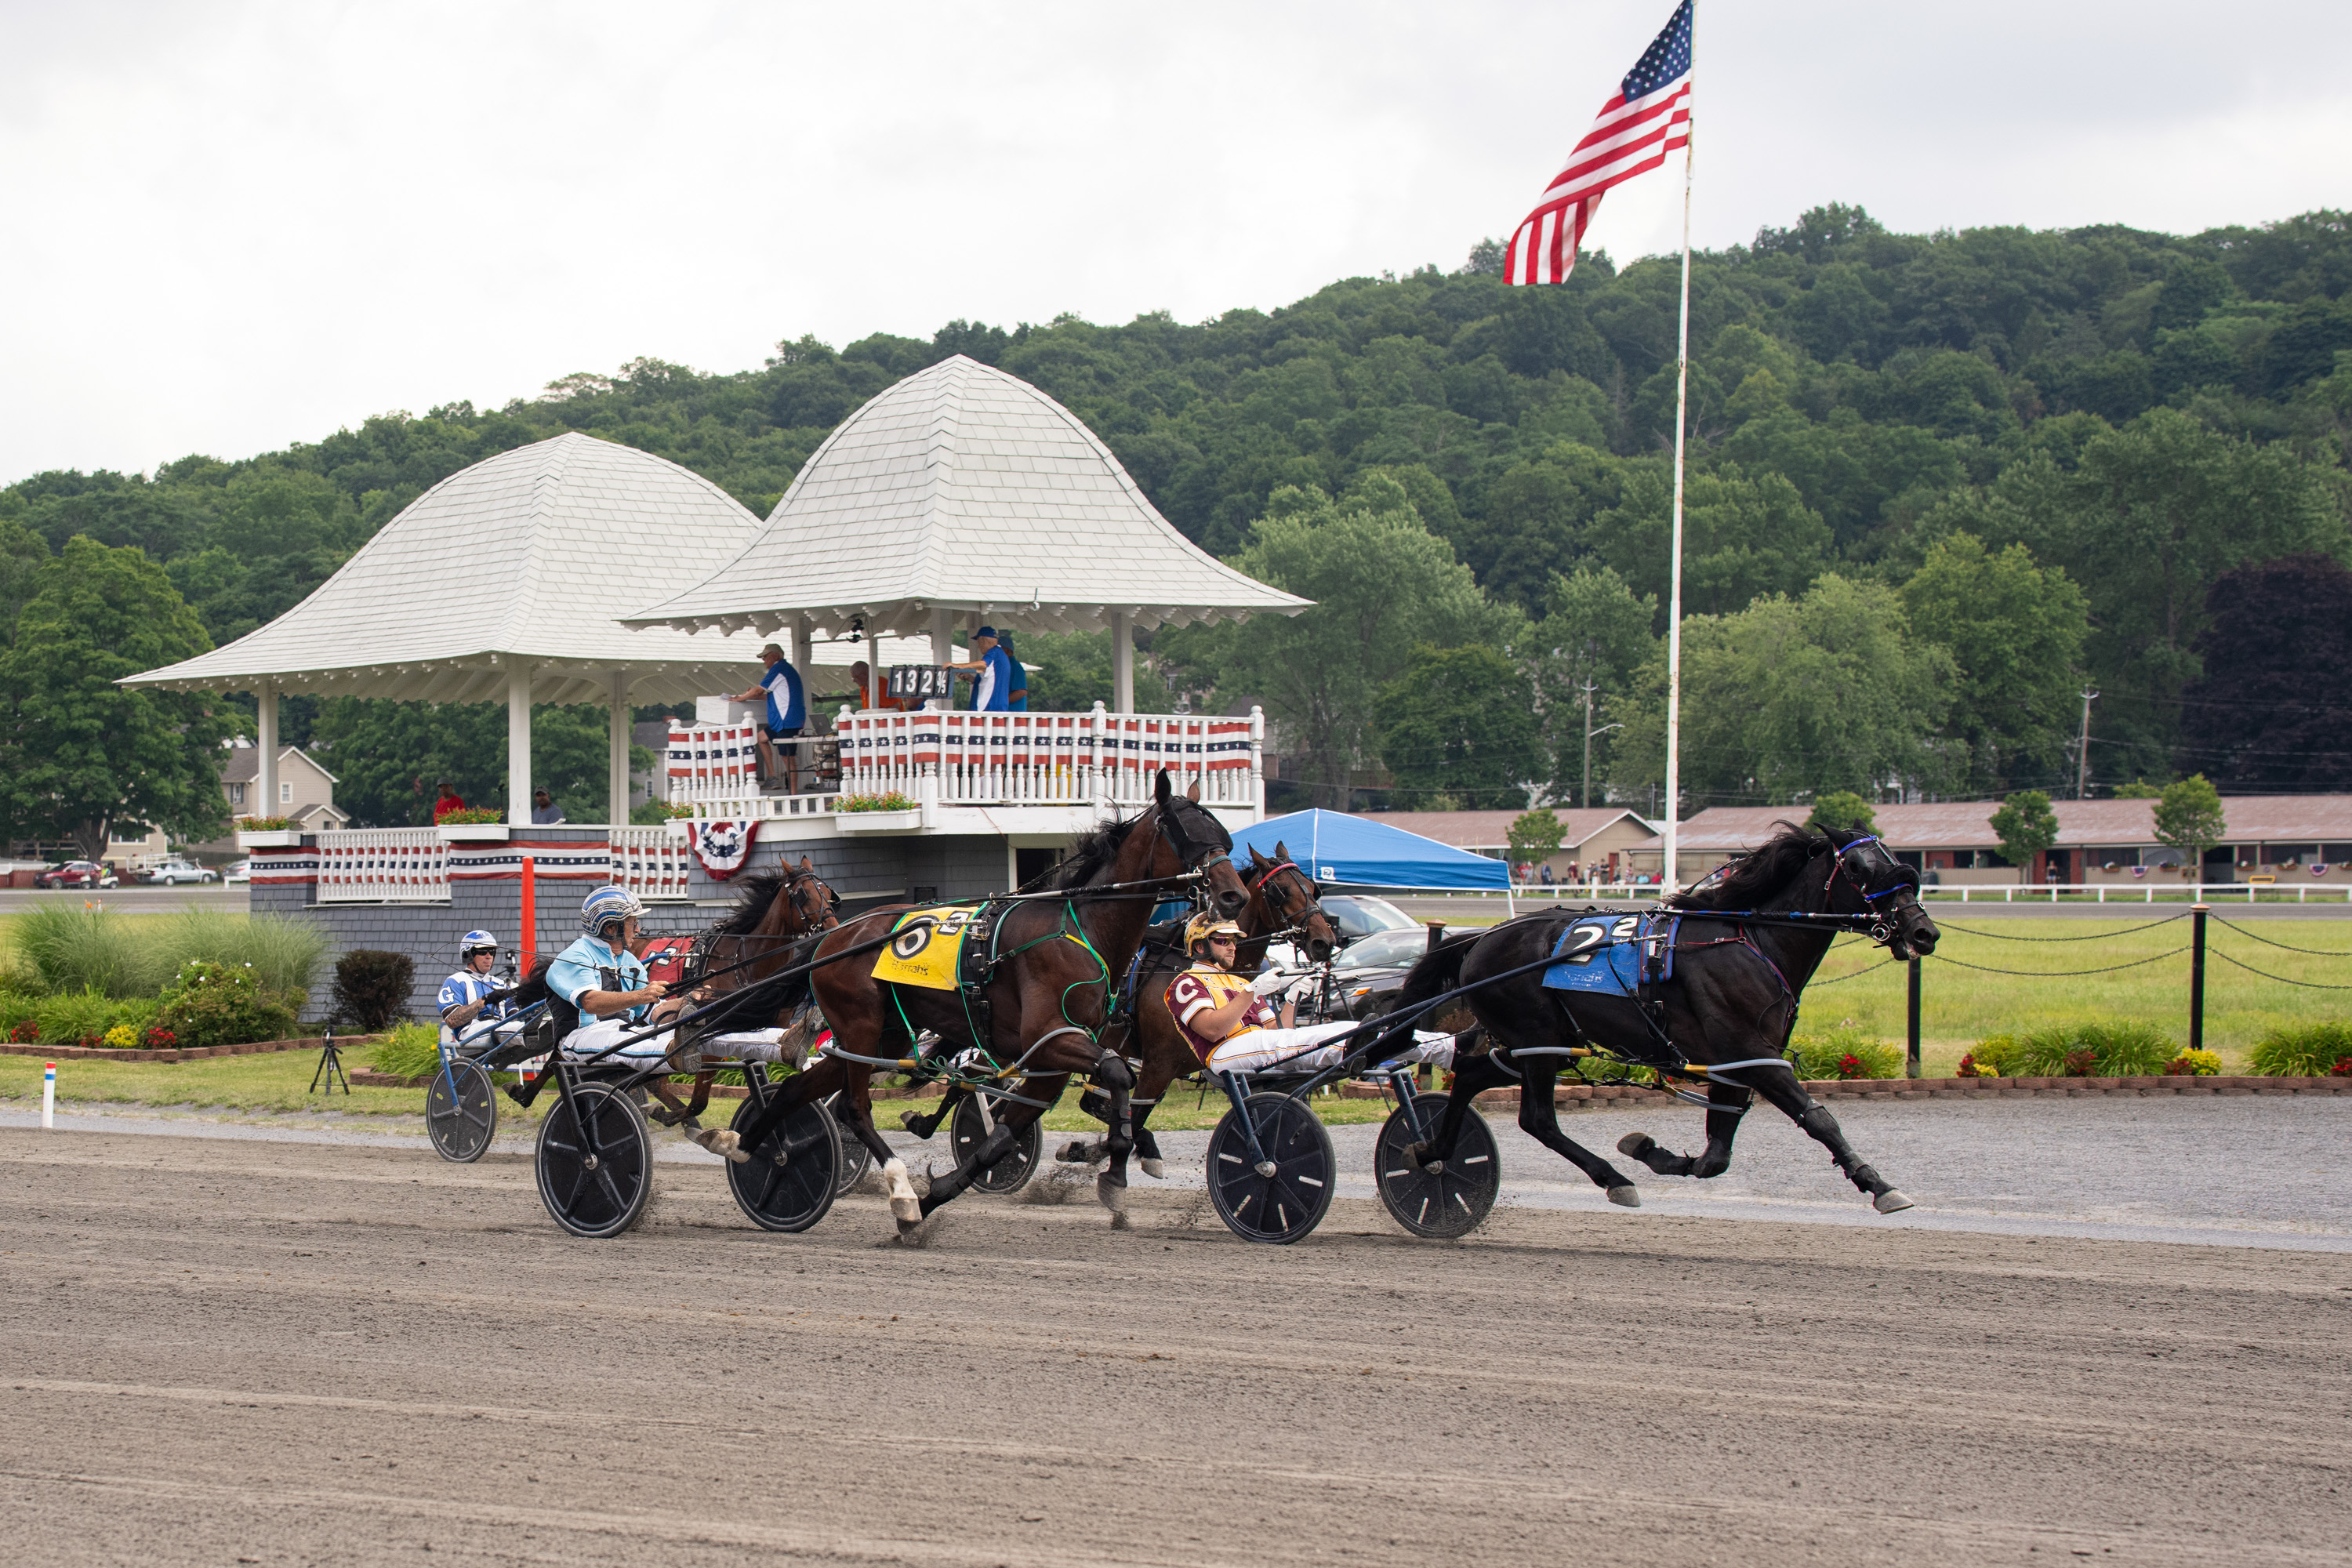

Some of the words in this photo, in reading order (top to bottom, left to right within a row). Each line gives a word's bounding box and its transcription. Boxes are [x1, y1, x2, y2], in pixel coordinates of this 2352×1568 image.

[938, 911, 970, 934] 2
[1611, 916, 1639, 938] 2
[1566, 926, 1604, 963] 2
[437, 985, 455, 1004] G
[1175, 977, 1199, 1004] C
